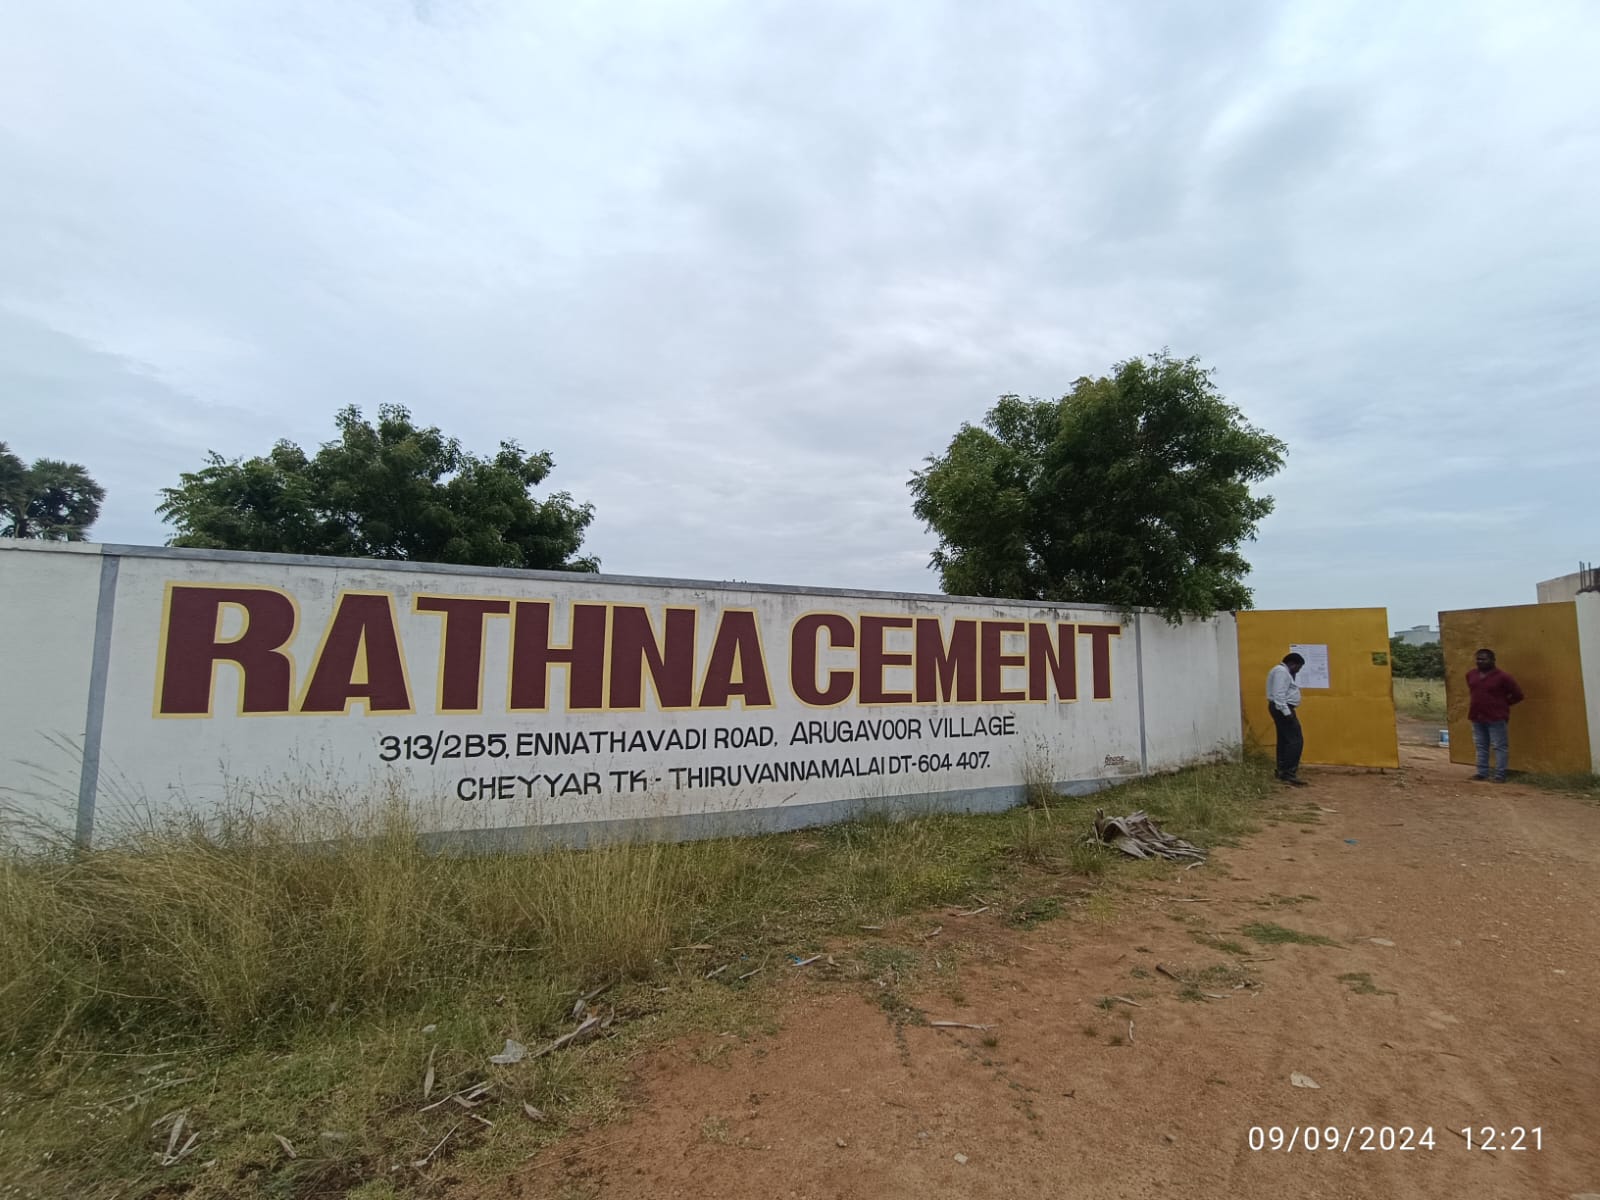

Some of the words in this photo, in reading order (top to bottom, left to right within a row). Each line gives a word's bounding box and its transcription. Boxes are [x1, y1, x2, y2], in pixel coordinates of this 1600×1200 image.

[152, 580, 776, 719] RATHNA
[789, 610, 1122, 709] CEMENT
[379, 730, 510, 765] 313/2B5,
[516, 728, 707, 757] ENNATHAVADI
[714, 726, 778, 749] ROAD,
[790, 720, 922, 746] ARUGAVOOR
[928, 715, 1019, 739] VILLAGE.
[457, 772, 602, 801] CHEYYAR
[668, 757, 886, 790] THIRUVANNAMALAI
